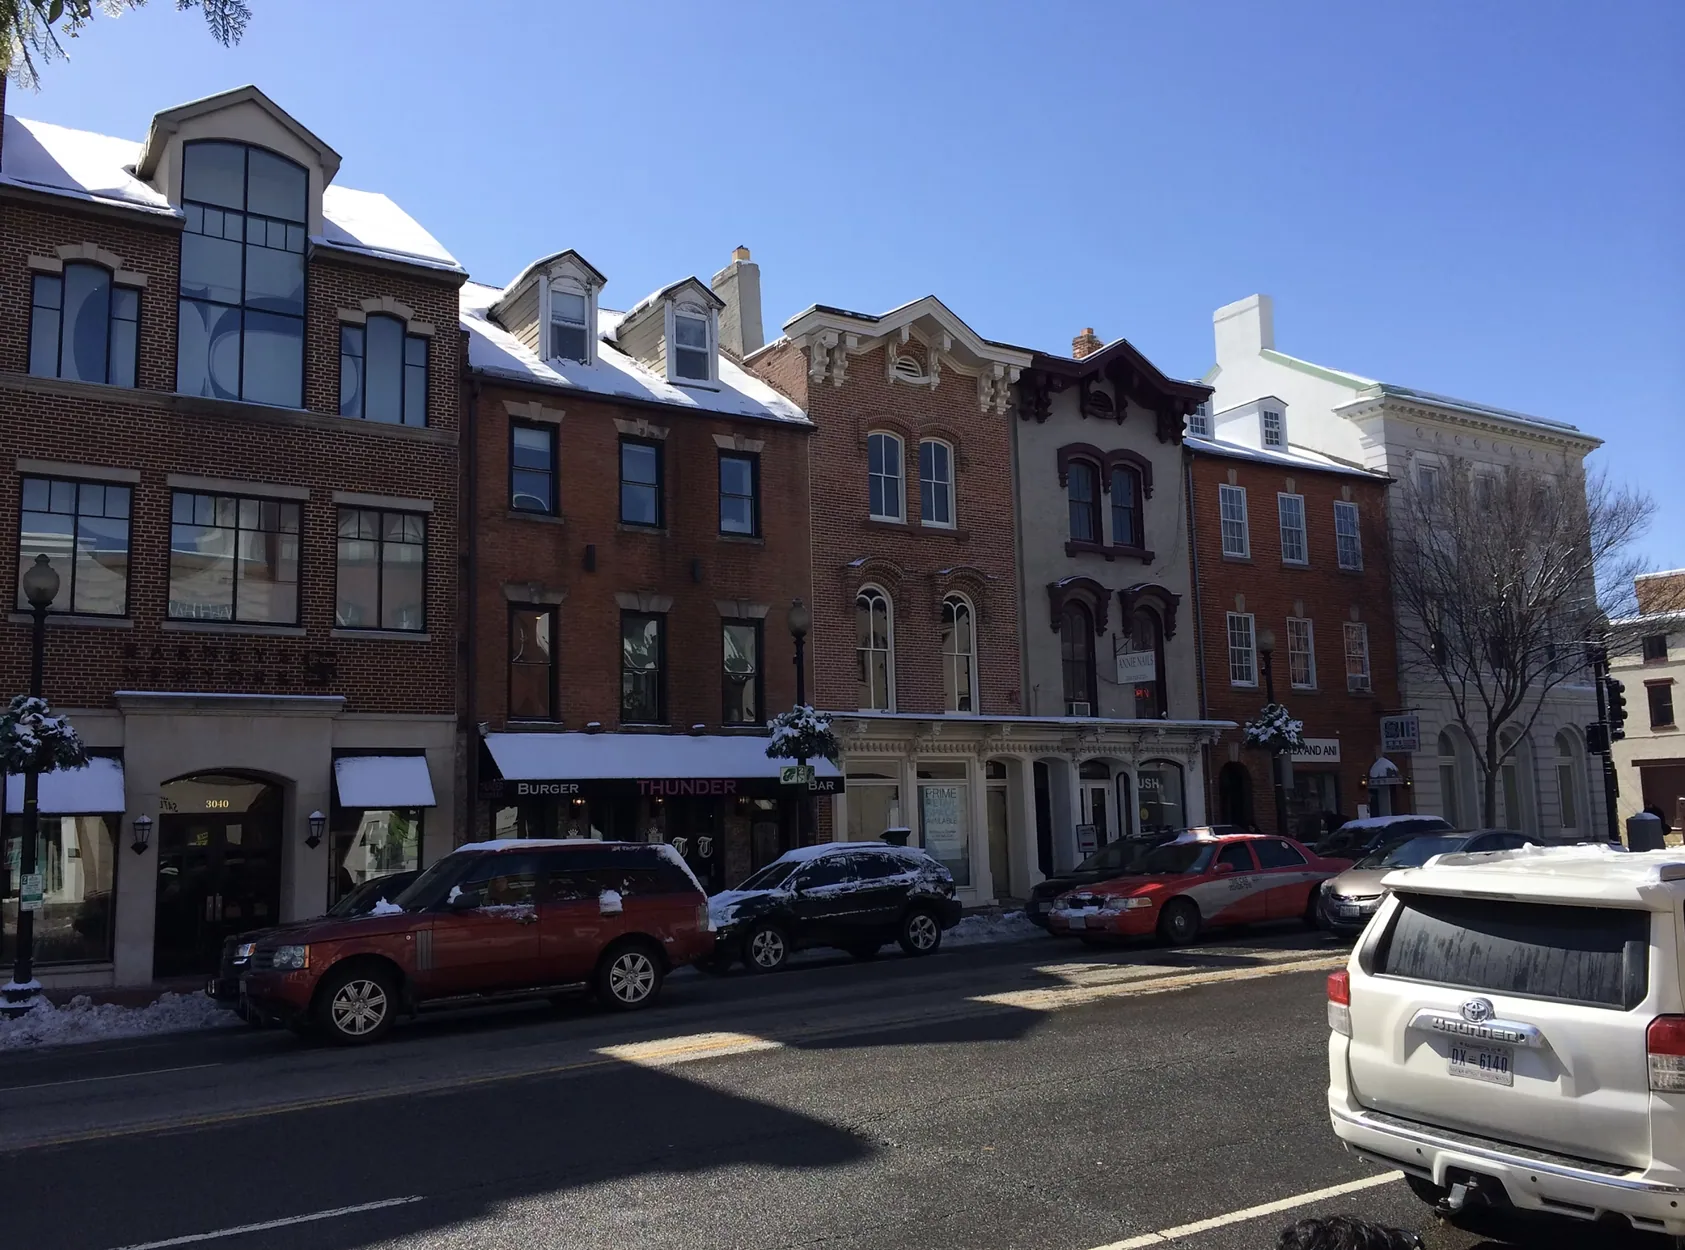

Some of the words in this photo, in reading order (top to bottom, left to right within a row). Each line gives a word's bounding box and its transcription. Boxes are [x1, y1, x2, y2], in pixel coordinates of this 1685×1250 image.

[1119, 656, 1137, 668] ANNIE
[1304, 745, 1321, 756] AND
[1323, 745, 1337, 756] ANI
[517, 782, 580, 795] BURGER
[636, 779, 738, 796] THUNDER
[808, 780, 835, 791] BAR
[925, 787, 957, 799] PRIME
[205, 799, 230, 809] 3040
[1432, 1017, 1519, 1044] 4RUNNER
[1451, 1047, 1467, 1067] DX
[1479, 1052, 1508, 1075] 6140
